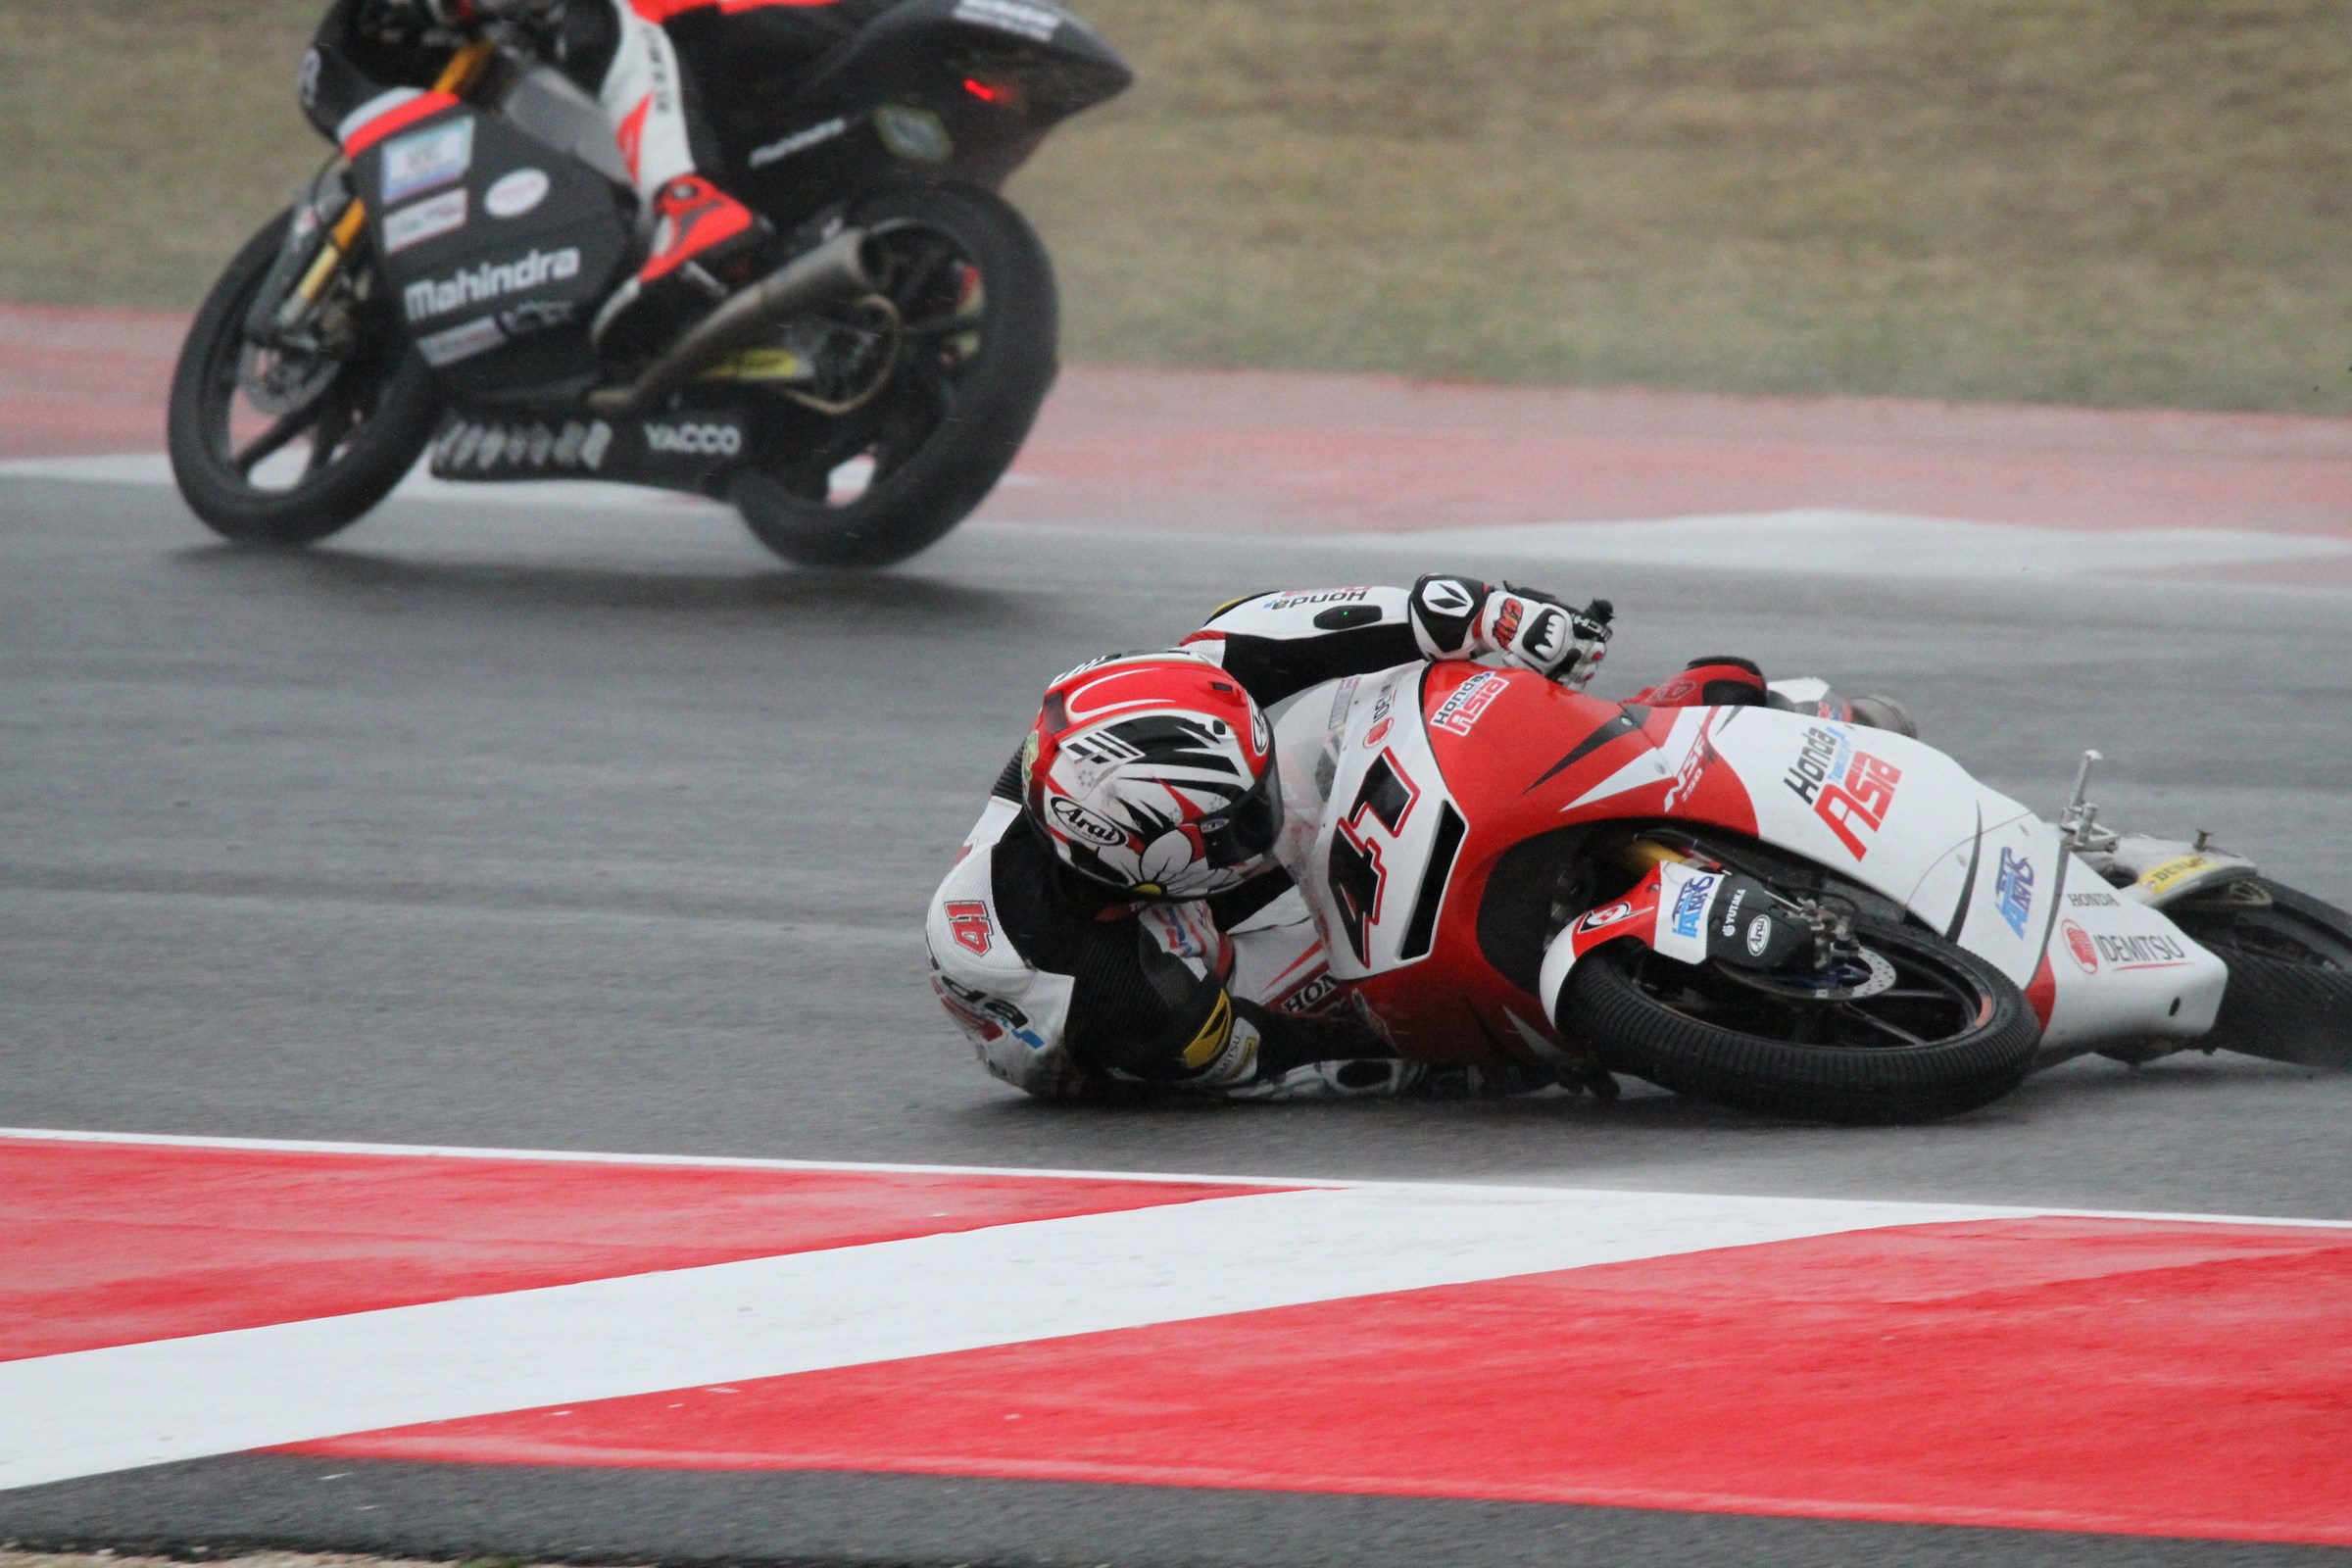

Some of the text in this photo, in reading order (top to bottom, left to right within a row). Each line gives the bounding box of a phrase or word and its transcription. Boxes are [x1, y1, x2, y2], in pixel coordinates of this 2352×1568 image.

[404, 247, 580, 322] Mahindra
[643, 421, 742, 457] YACCO
[1433, 674, 1484, 725] Honda
[1783, 725, 1838, 806] Honda
[1053, 802, 1117, 842] Arai
[1813, 750, 1903, 862] Asia
[1328, 747, 1420, 968] 41
[2067, 894, 2120, 906] HONDA
[2092, 934, 2186, 962] IDEMITSU
